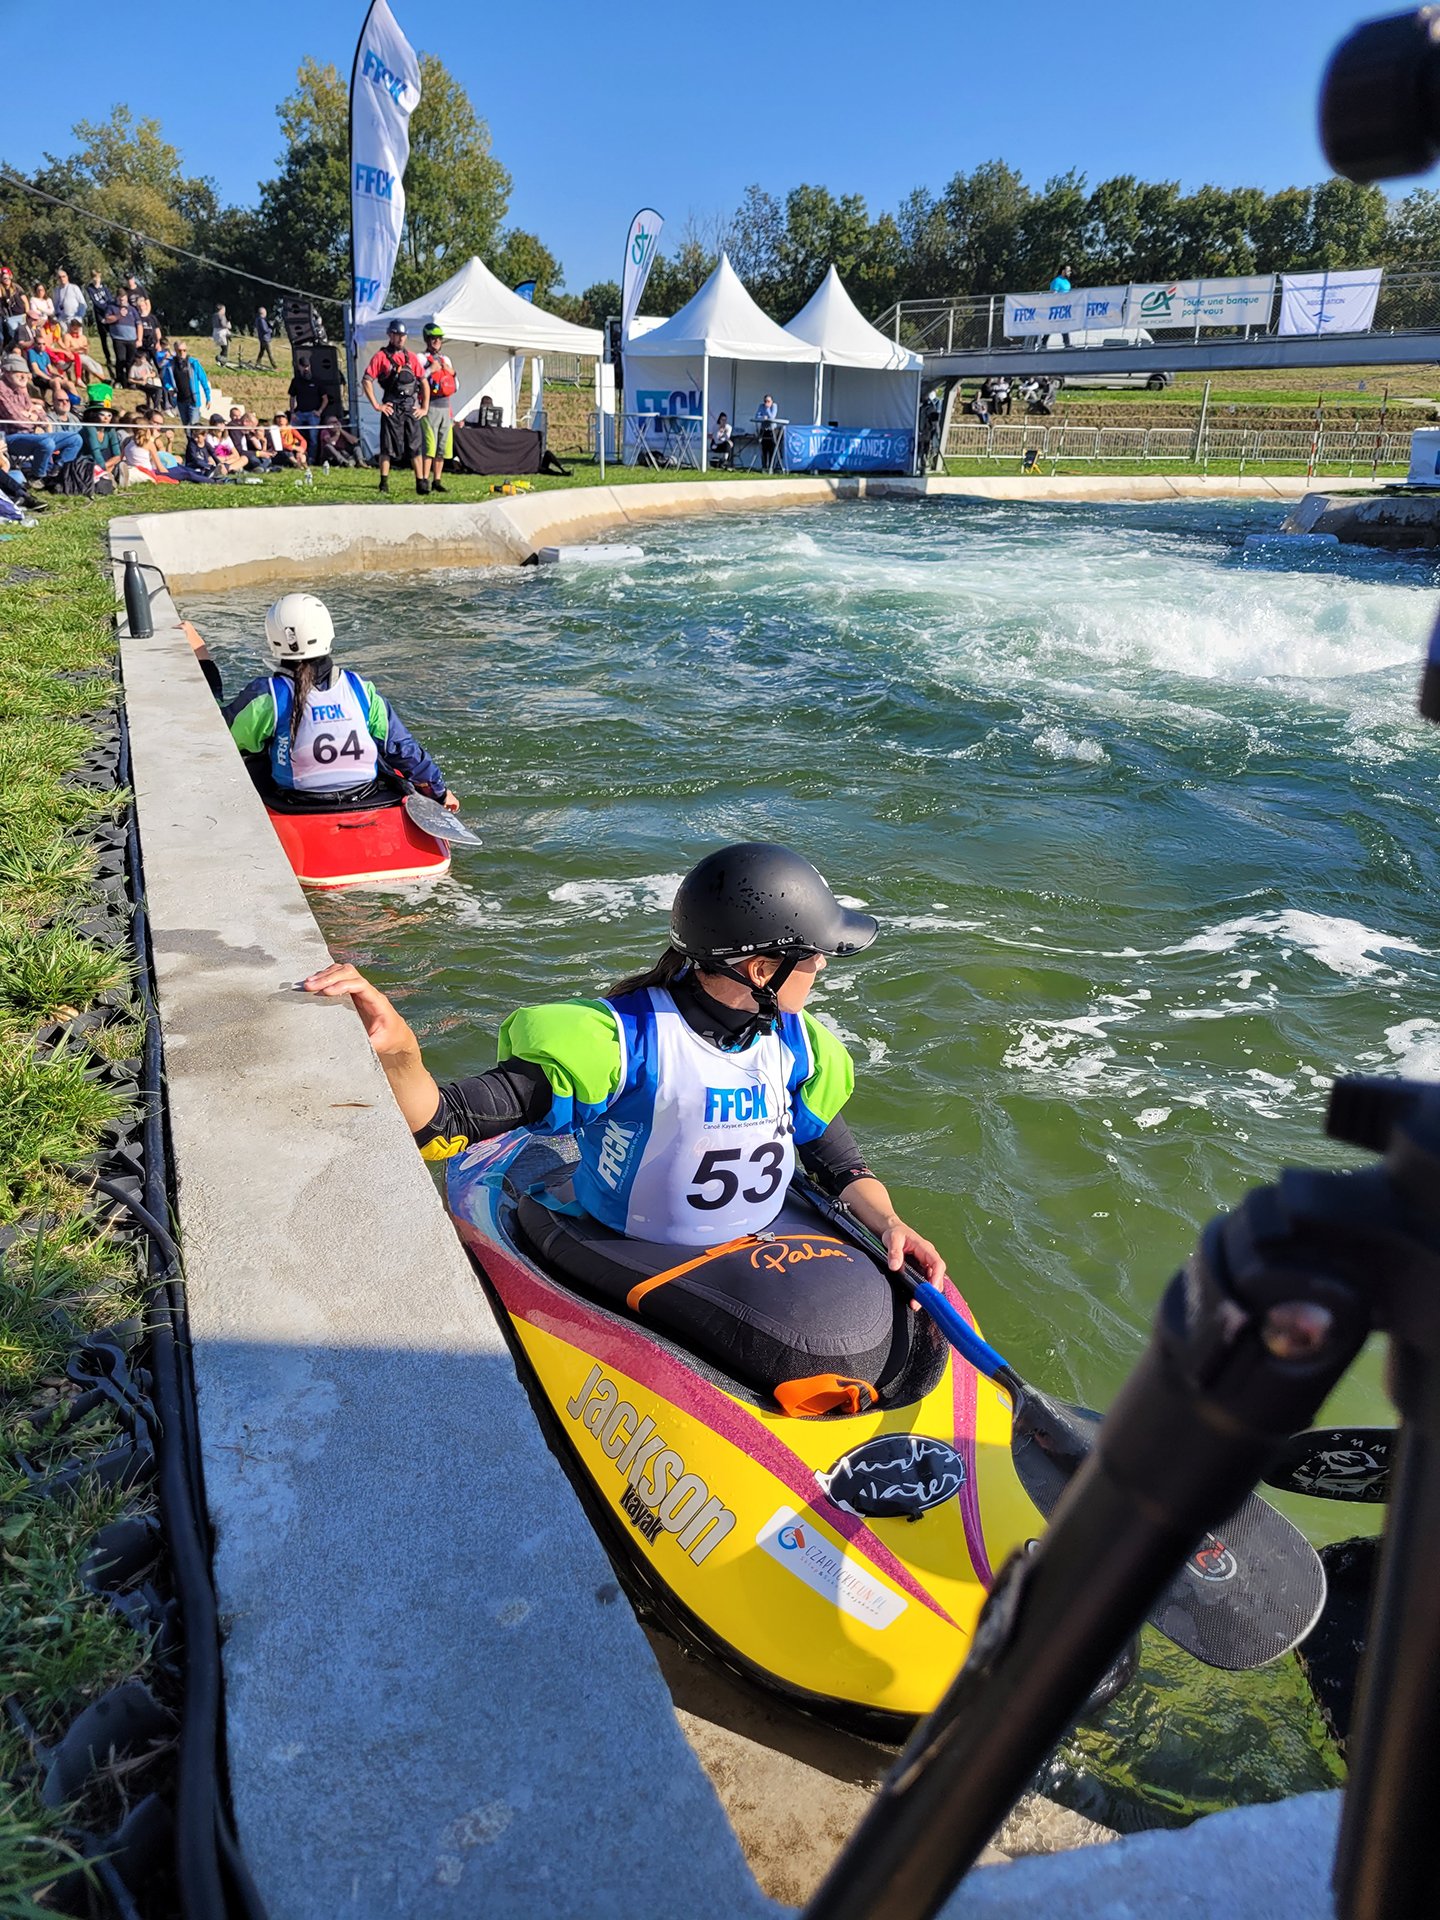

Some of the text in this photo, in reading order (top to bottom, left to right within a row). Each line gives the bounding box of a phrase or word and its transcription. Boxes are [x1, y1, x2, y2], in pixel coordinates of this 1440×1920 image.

[362, 49, 407, 105] FFCK
[356, 163, 395, 200] FFCK
[1014, 308, 1036, 322] FFCK
[1048, 305, 1072, 320] FFCK
[1086, 302, 1110, 317] FFCK
[1182, 309, 1201, 317] pour
[1226, 296, 1260, 307] banque
[636, 390, 704, 433] FFCK
[834, 438, 846, 454] LA
[849, 439, 885, 459] FRANCE
[312, 704, 345, 721] FFCK
[277, 735, 289, 767] FFCK
[313, 729, 364, 764] 64
[704, 1083, 768, 1122] FFCK
[597, 1119, 635, 1190] FFCK
[686, 1142, 784, 1210] 53
[751, 1243, 848, 1273] Palm
[566, 1363, 737, 1567] Jackson
[619, 1482, 665, 1547] kayak
